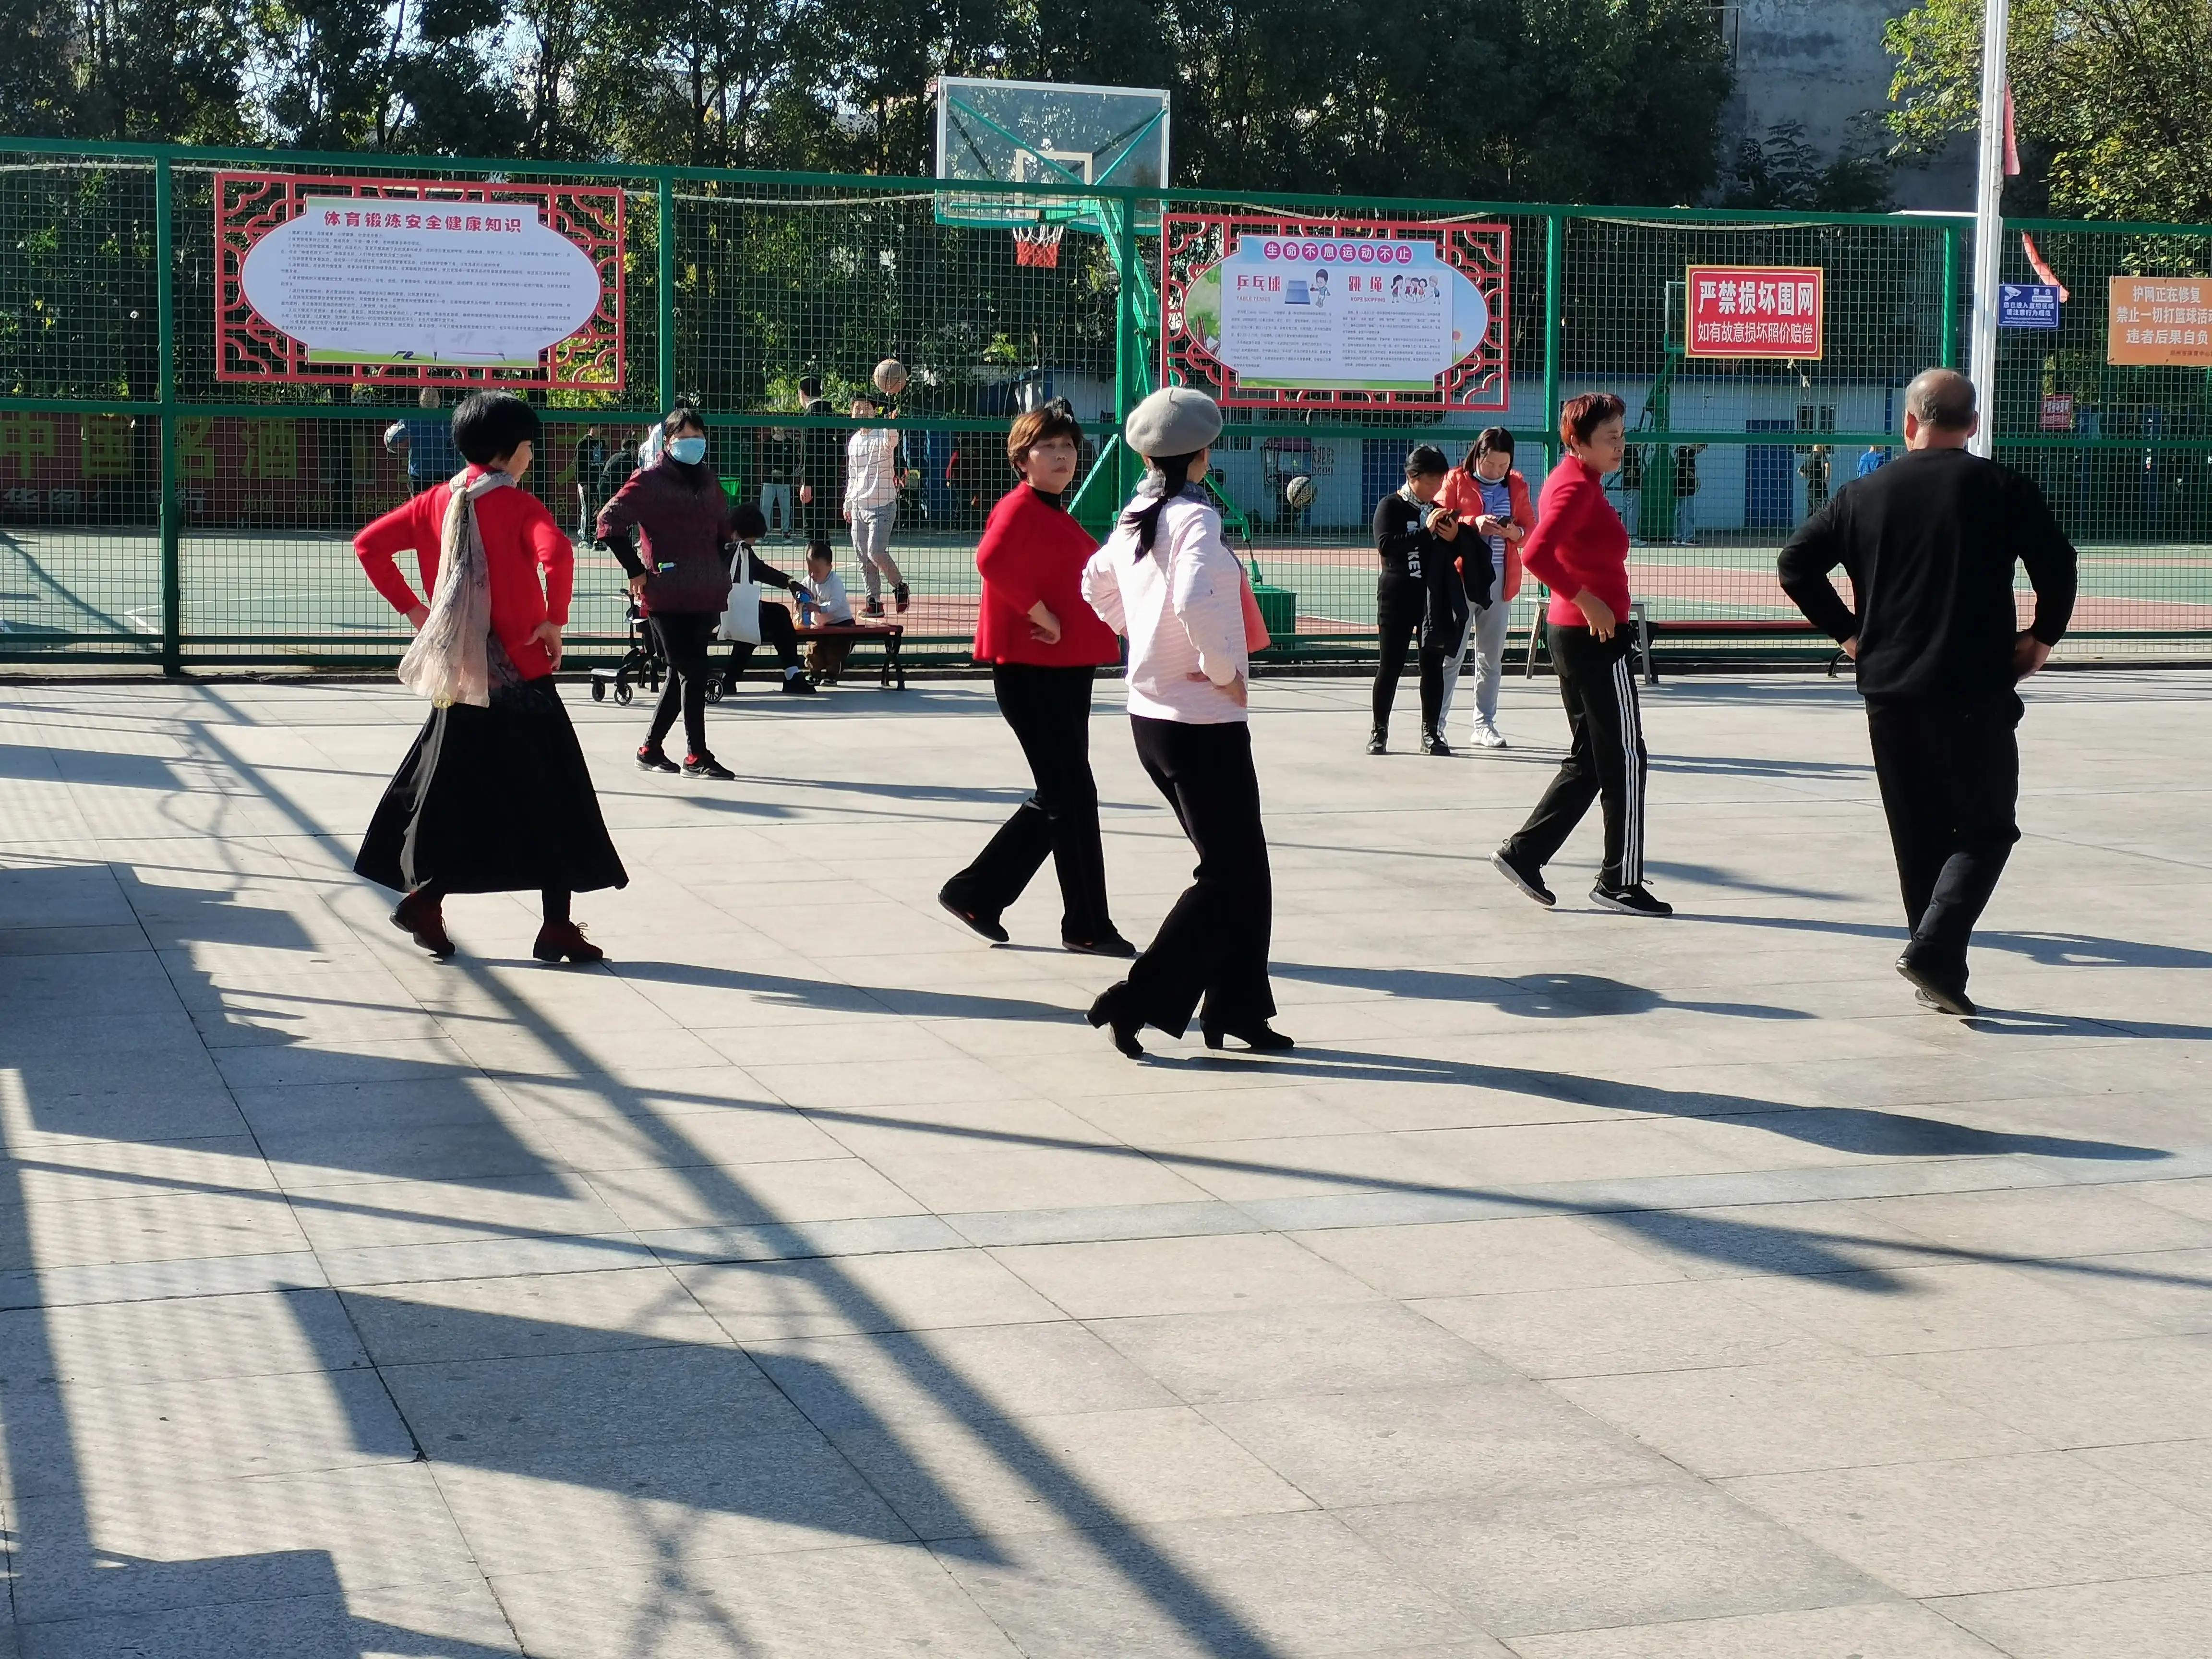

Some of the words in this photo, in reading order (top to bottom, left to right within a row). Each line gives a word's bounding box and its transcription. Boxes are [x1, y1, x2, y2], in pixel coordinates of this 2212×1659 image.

[324, 211, 521, 233] 体育锻炼安全健康知识
[1266, 243, 1409, 260] 生命不息运动不止
[1236, 275, 1281, 292] 乒乓球
[1348, 276, 1382, 292] 跳绳
[1698, 280, 1814, 316] 严禁损坏围网
[2132, 285, 2201, 304] 护网正在修复
[1697, 320, 1813, 344] 如有故意损坏照价赔偿
[2126, 328, 2209, 345] 违者后果自负
